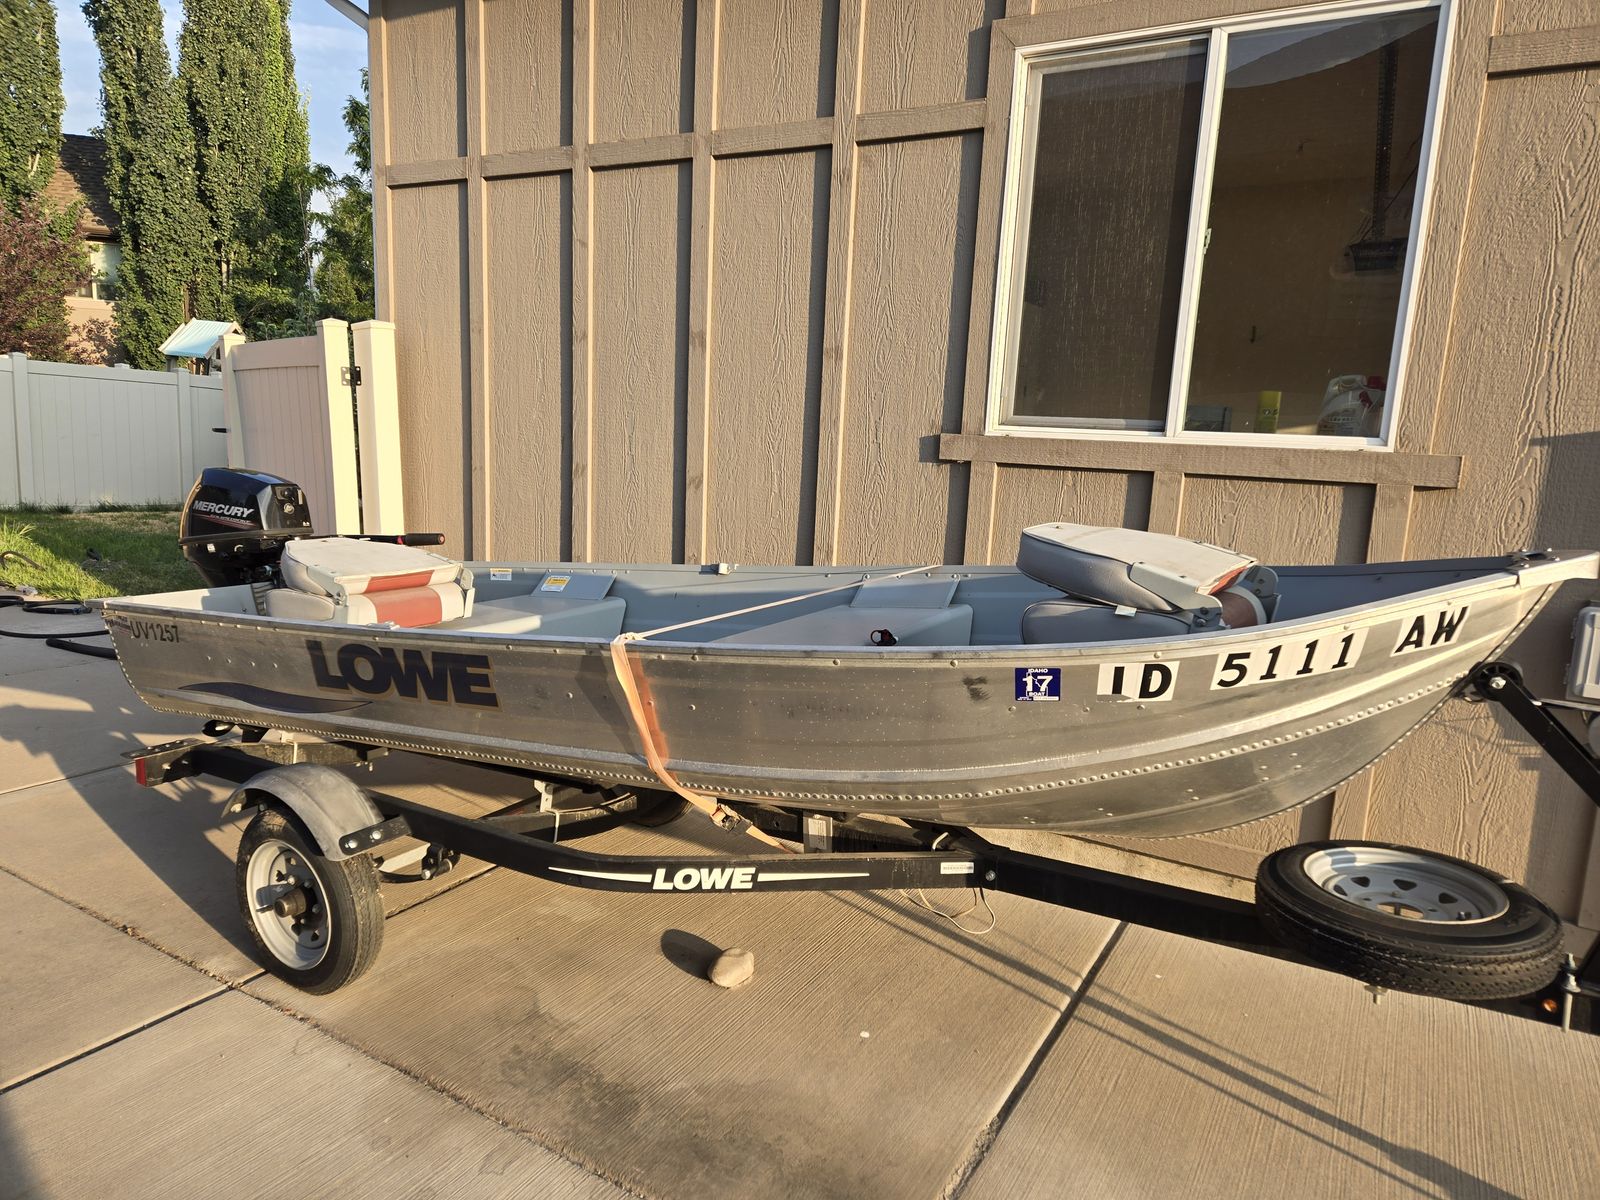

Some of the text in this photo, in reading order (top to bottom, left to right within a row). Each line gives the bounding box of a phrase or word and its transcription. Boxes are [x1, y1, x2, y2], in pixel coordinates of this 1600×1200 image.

[193, 501, 254, 518] MERCURY
[130, 621, 179, 643] UV1257
[1112, 606, 1469, 699] ID 5111 AW
[305, 639, 500, 709] LOWE
[1022, 675, 1053, 692] 17
[652, 867, 756, 890] LOWE
